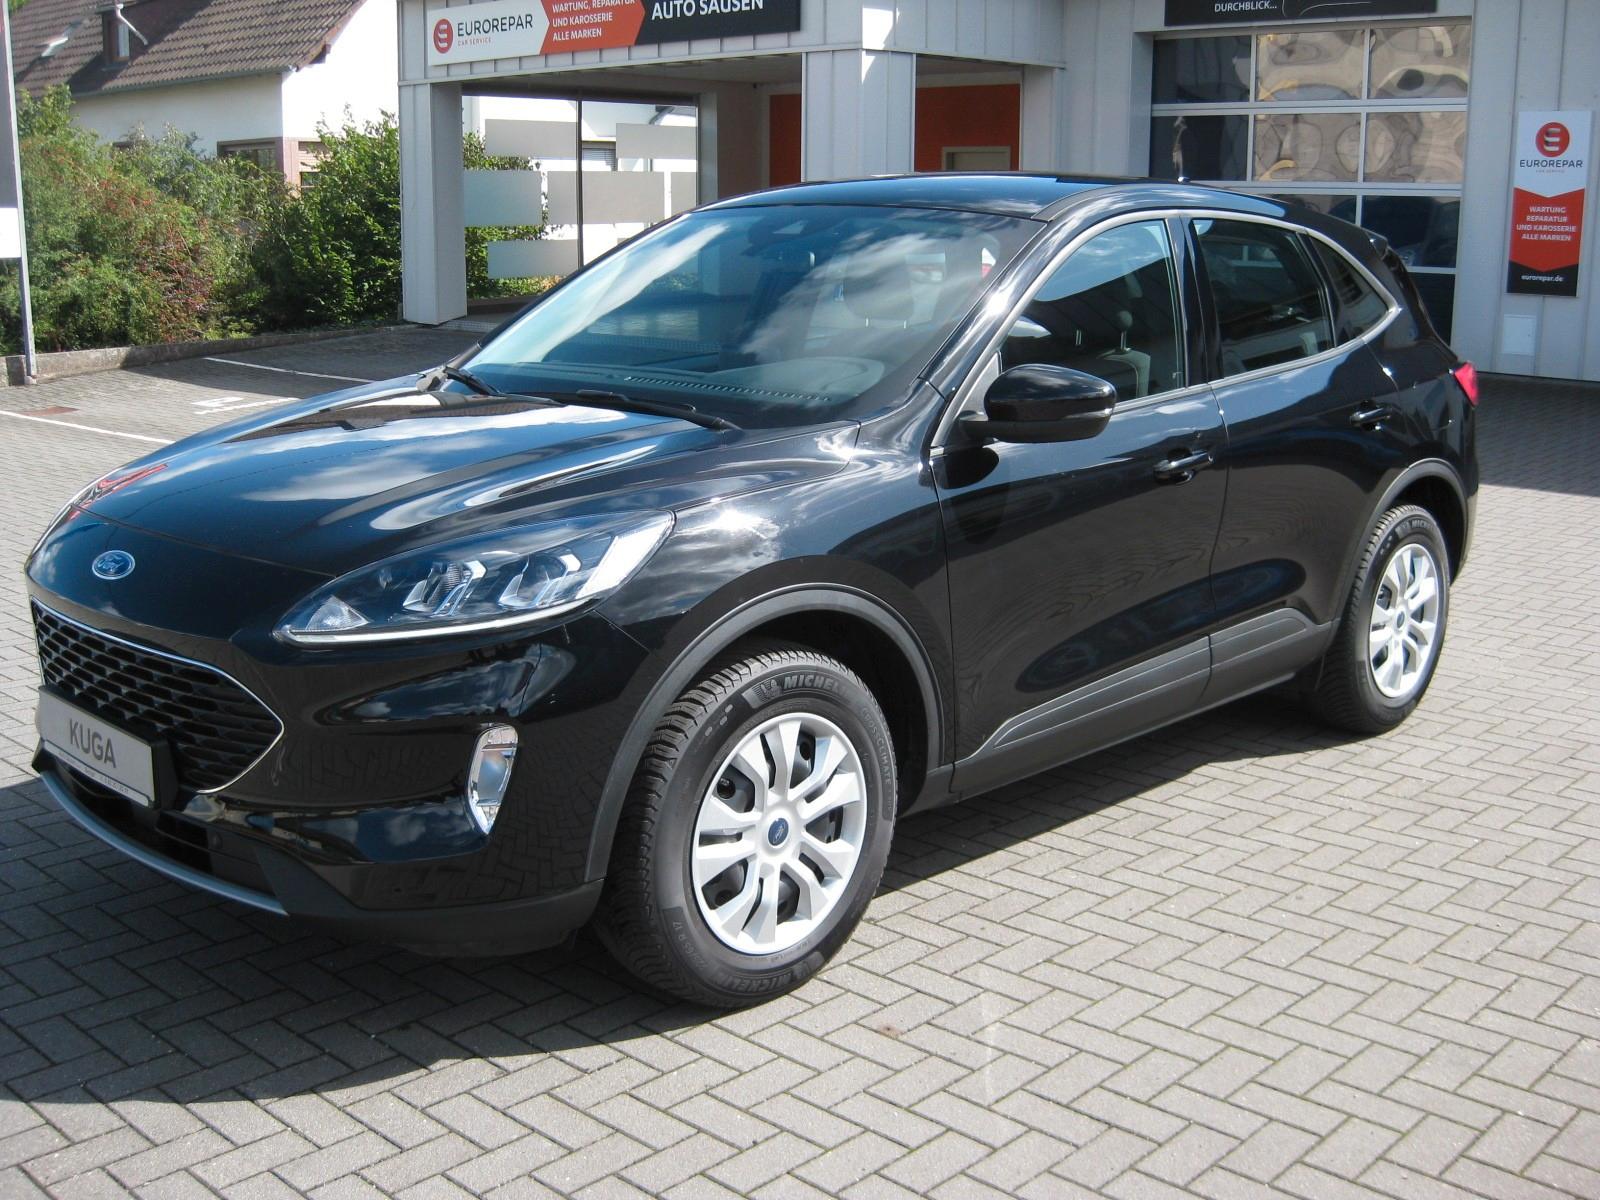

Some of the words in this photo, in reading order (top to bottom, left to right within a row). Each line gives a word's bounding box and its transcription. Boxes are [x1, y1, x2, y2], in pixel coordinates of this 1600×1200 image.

[552, 1, 590, 13] WARTUNG,
[651, 0, 696, 20] AUTO
[699, 0, 764, 15] SAUSEN
[1214, 0, 1277, 13] DURCHBLICK...
[457, 13, 533, 37] EUROREPAR
[552, 17, 568, 28] UND
[569, 12, 613, 26] KAROSSERIE
[552, 31, 569, 42] ALLE
[570, 28, 602, 40] MARKEN
[469, 37, 491, 46] SERVICE
[1519, 159, 1584, 168] EUROREPAR
[1529, 206, 1566, 214] WARTUNG
[1526, 215, 1568, 223] REPARATUR
[1516, 223, 1532, 231] UND
[1533, 224, 1577, 233] KAROSSERIE
[1521, 274, 1564, 282] eurorepar.de
[784, 674, 847, 697] MICHELI
[69, 718, 117, 769] KUGA
